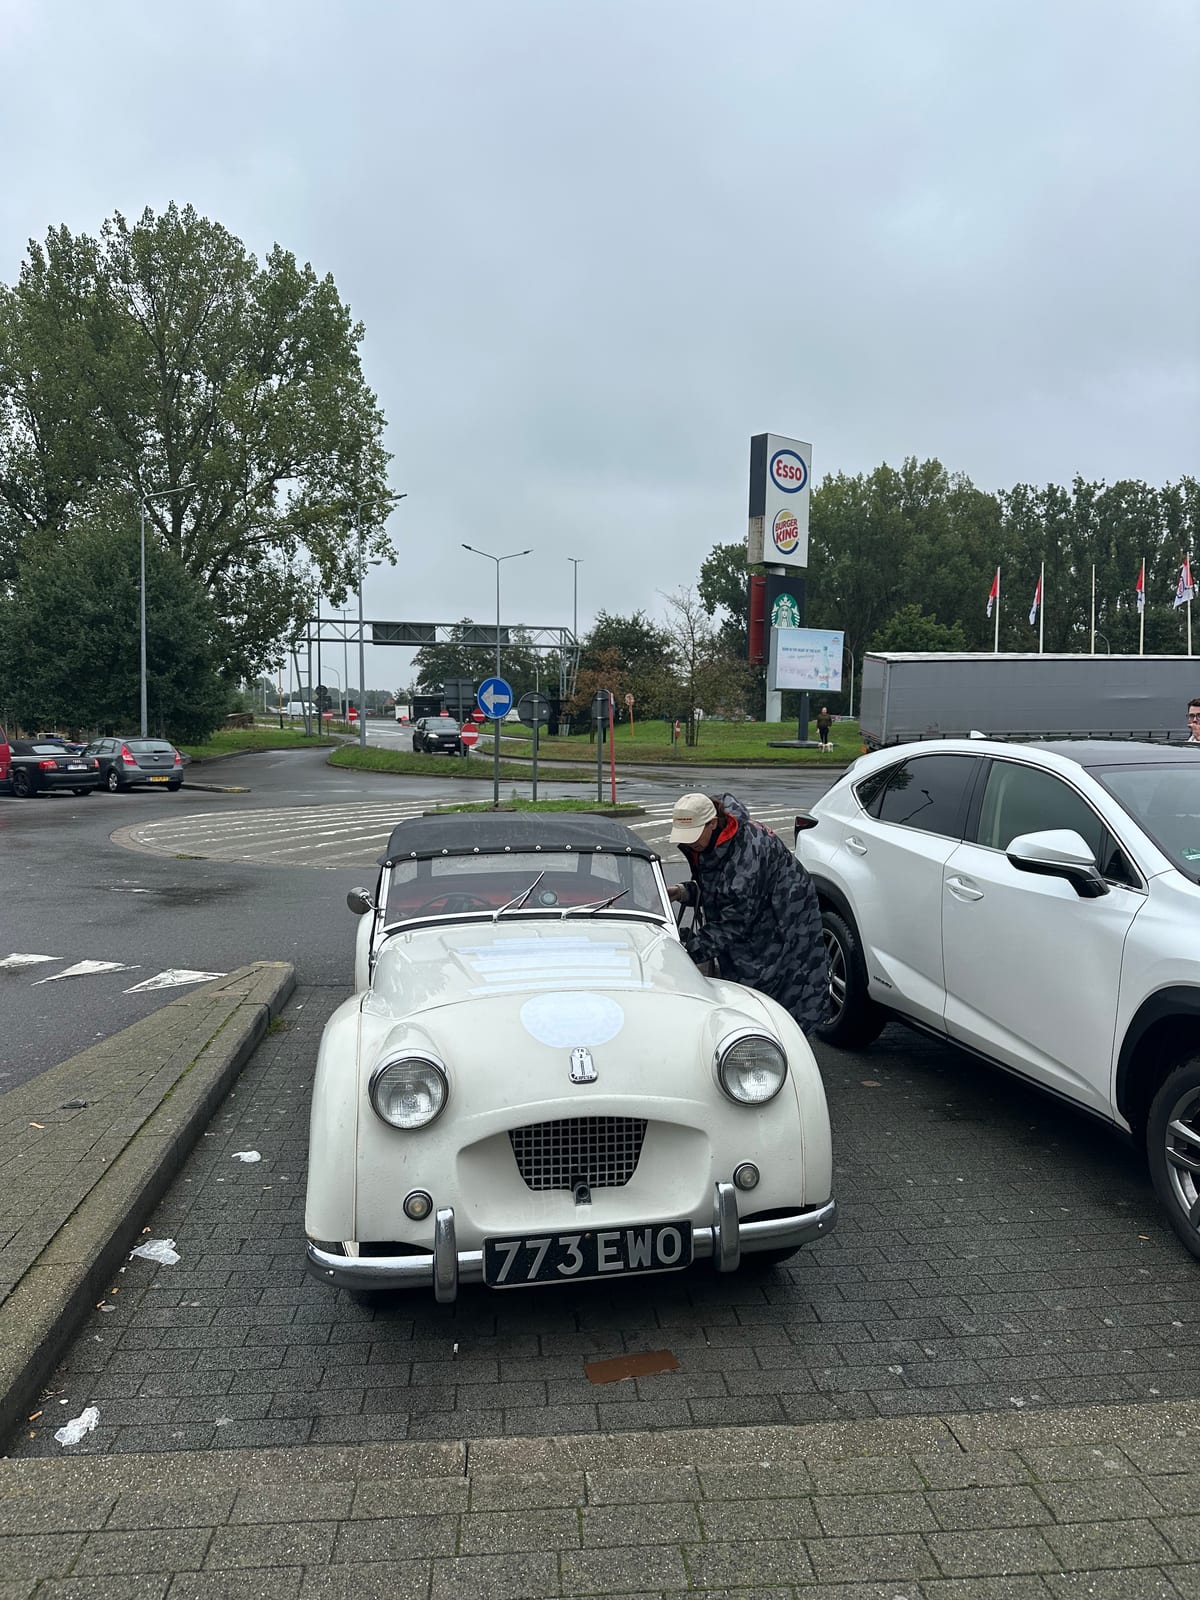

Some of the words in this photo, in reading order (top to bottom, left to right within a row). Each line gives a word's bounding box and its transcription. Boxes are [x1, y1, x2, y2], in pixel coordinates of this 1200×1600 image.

[775, 518, 798, 532] BURGER
[775, 527, 799, 544] KING
[494, 1235, 584, 1283] 773
[597, 1226, 682, 1272] EWO
